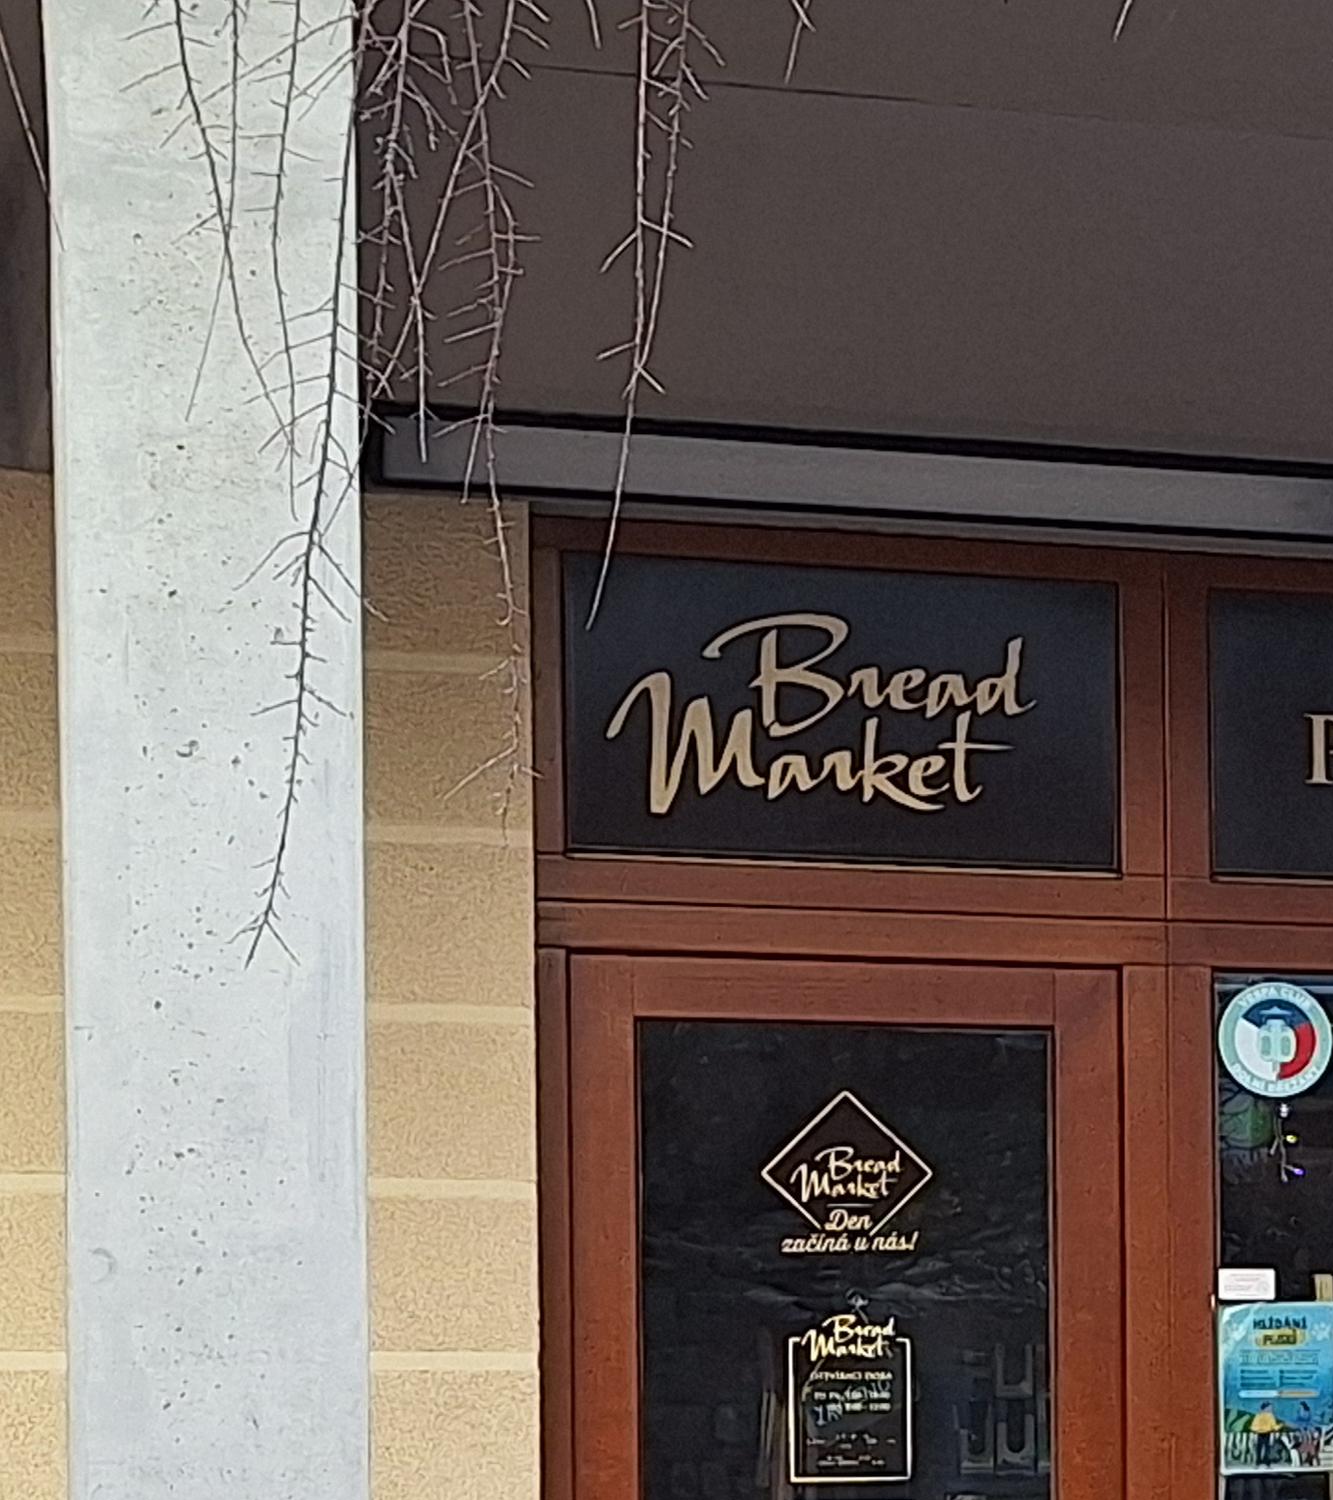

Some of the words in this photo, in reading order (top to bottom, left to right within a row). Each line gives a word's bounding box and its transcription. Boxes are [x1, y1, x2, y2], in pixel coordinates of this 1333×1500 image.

[700, 611, 1037, 738] Bread
[604, 670, 1015, 815] Market
[814, 1146, 902, 1181] Bread
[789, 1162, 899, 1203] Market
[824, 1208, 872, 1231] Den
[780, 1232, 851, 1253] začíná
[854, 1236, 871, 1251] u
[871, 1230, 920, 1251] nás!
[822, 1314, 896, 1343] Bread
[800, 1329, 885, 1363] Market
